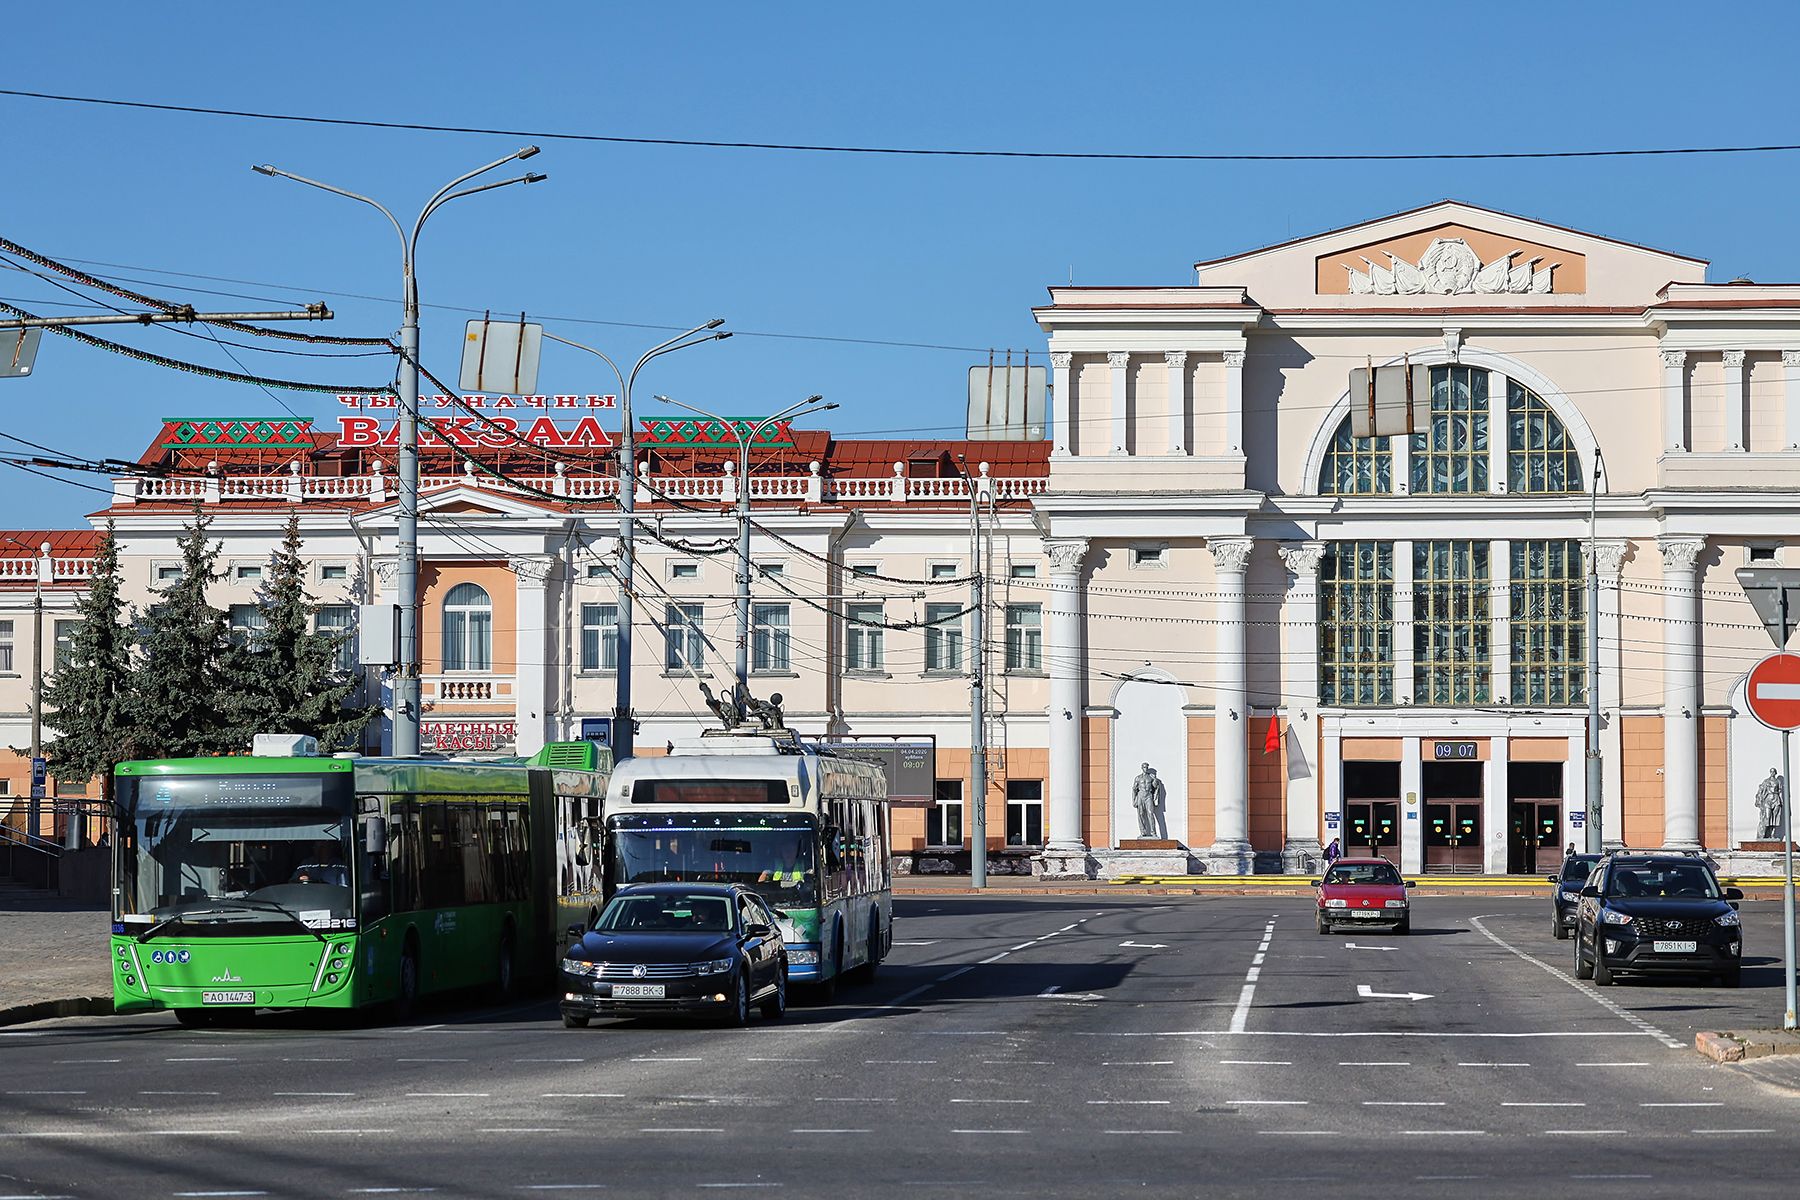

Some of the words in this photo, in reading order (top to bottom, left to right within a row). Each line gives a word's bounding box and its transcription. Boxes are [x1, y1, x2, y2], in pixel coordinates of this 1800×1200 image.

[337, 395, 616, 408] ЧЫУНАЧНЫ
[436, 735, 493, 749] КАСЫ
[1436, 744, 1451, 757] 09
[1459, 744, 1474, 757] 07
[903, 761, 925, 769] 09:07
[620, 986, 640, 995] 7888
[642, 986, 664, 995] BK-3
[210, 992, 224, 1002] AO
[225, 992, 253, 1002] 1447-3
